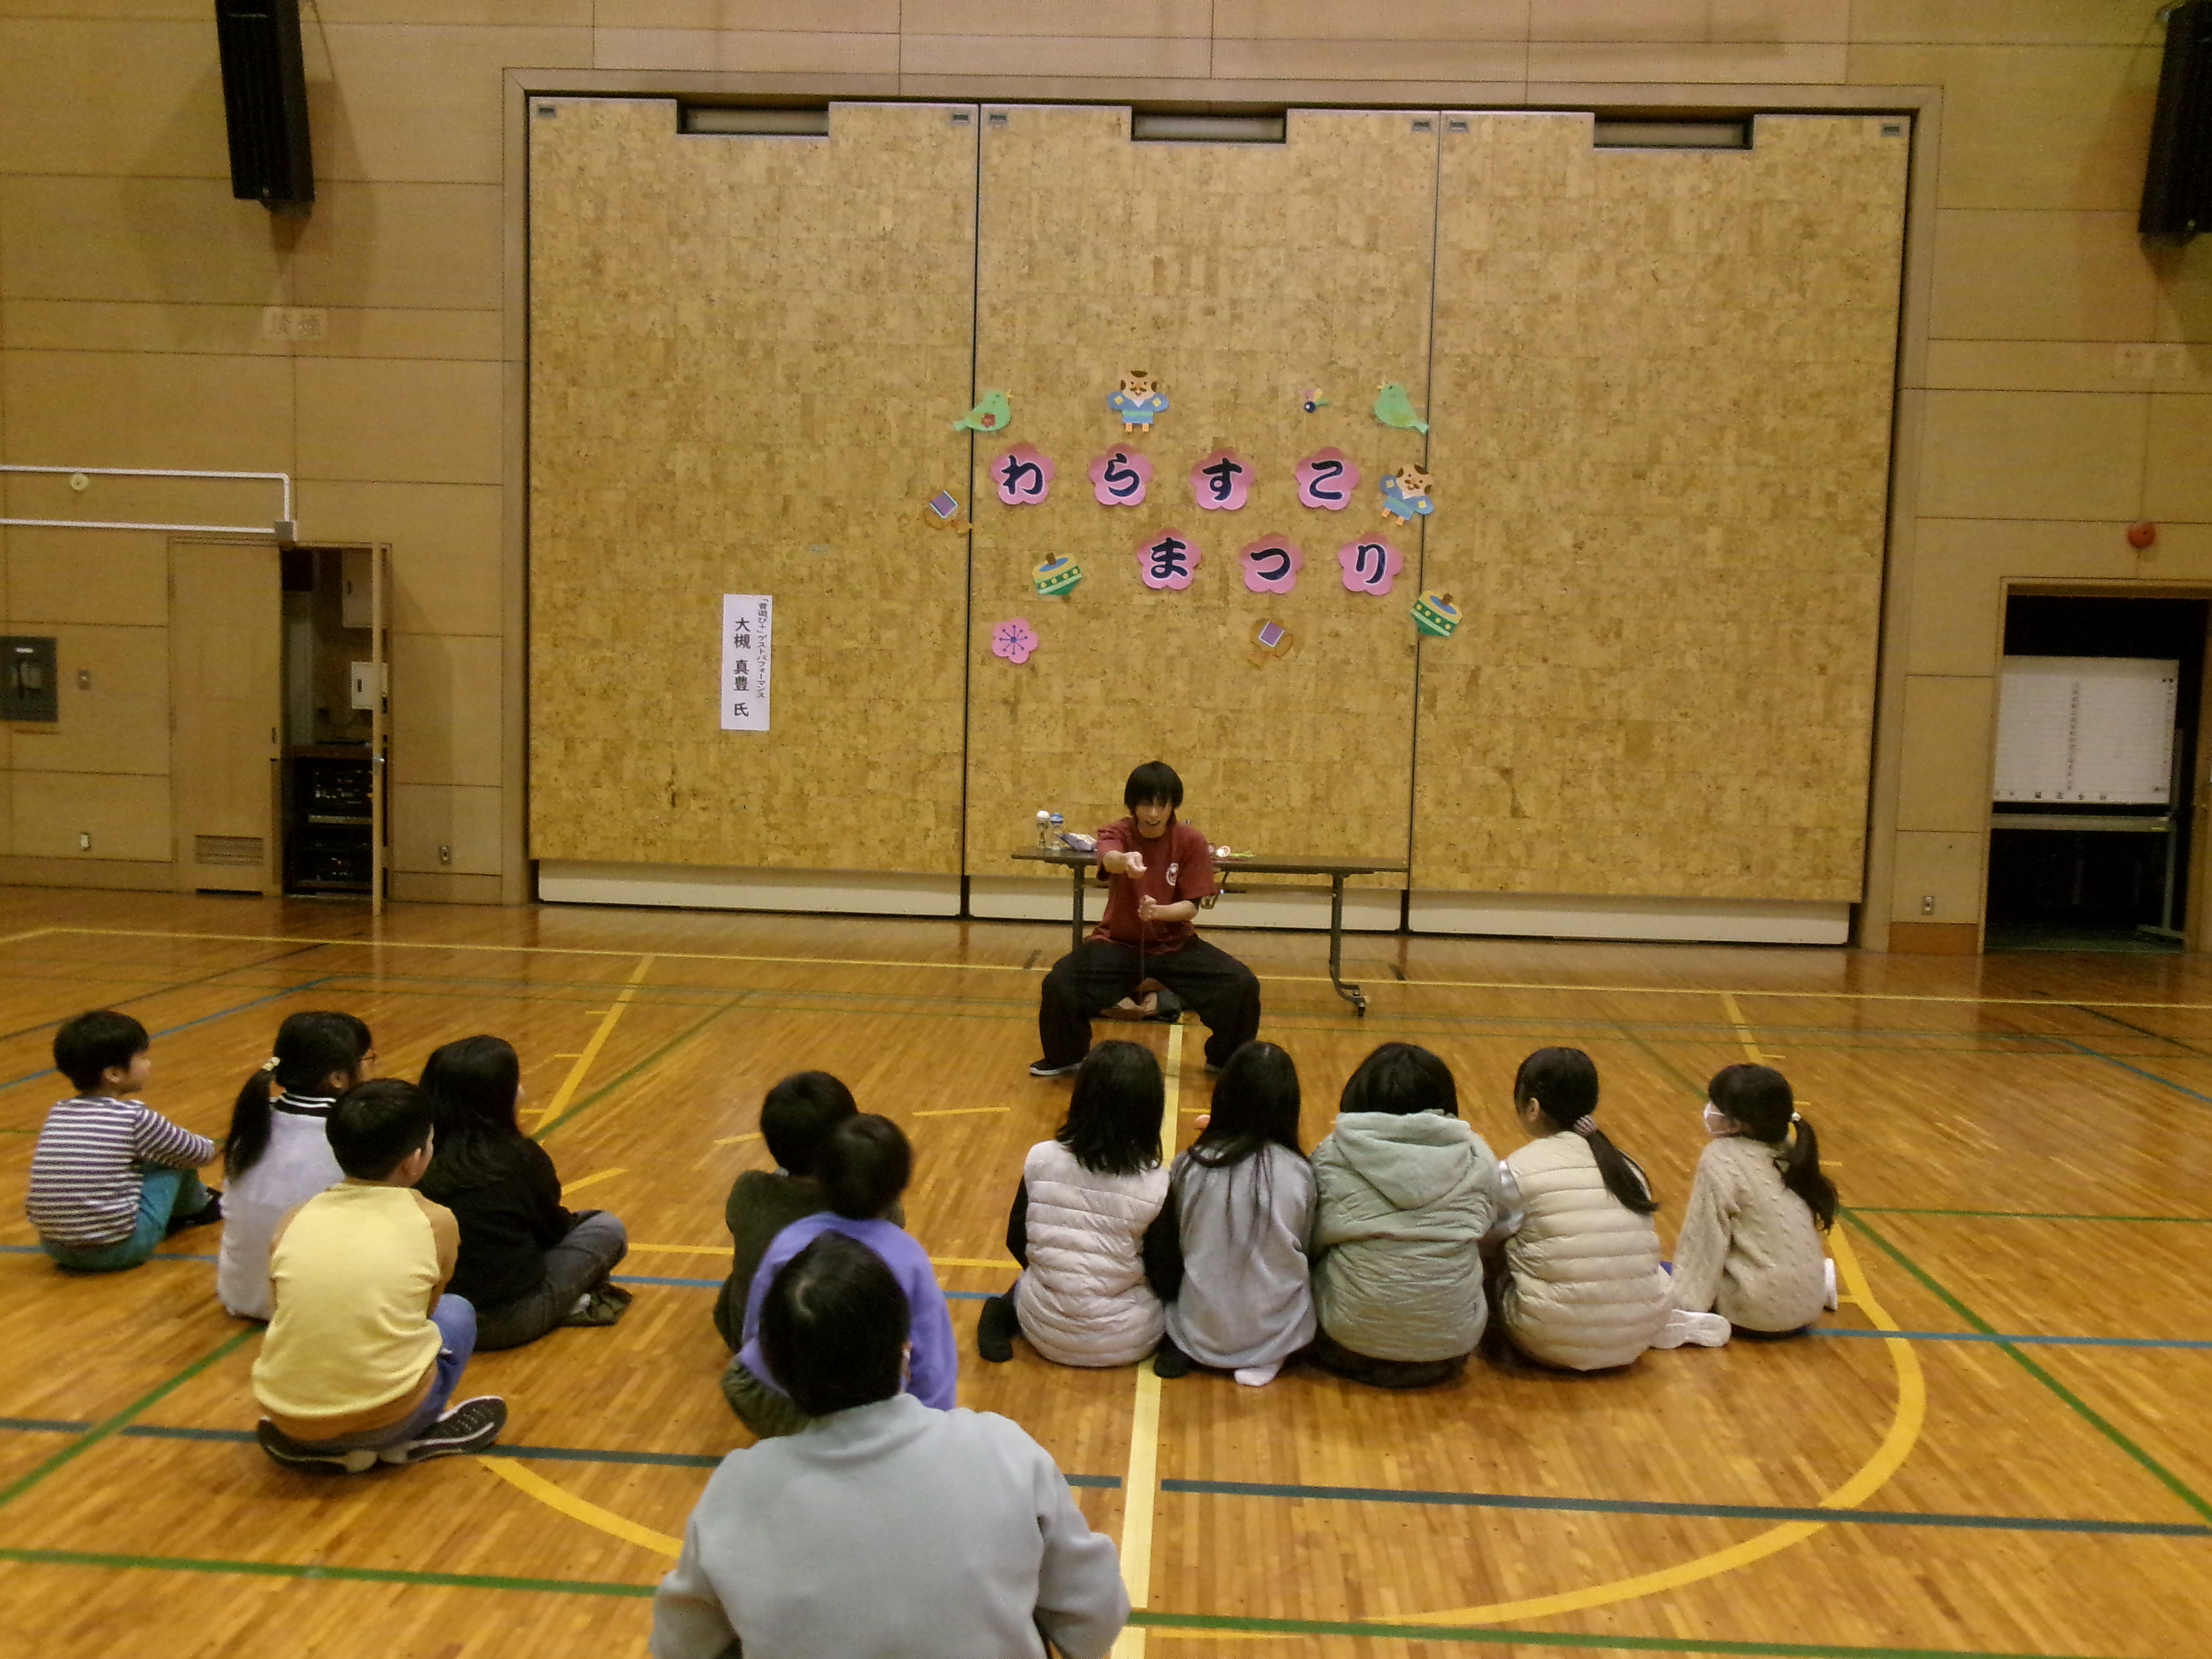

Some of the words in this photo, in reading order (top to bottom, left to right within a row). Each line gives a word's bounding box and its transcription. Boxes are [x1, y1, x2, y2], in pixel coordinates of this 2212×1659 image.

[1001, 454, 1345, 502] わらすこ
[1150, 536, 1386, 585] まつり
[733, 617, 751, 649] 大槻
[734, 702, 749, 717] 氏
